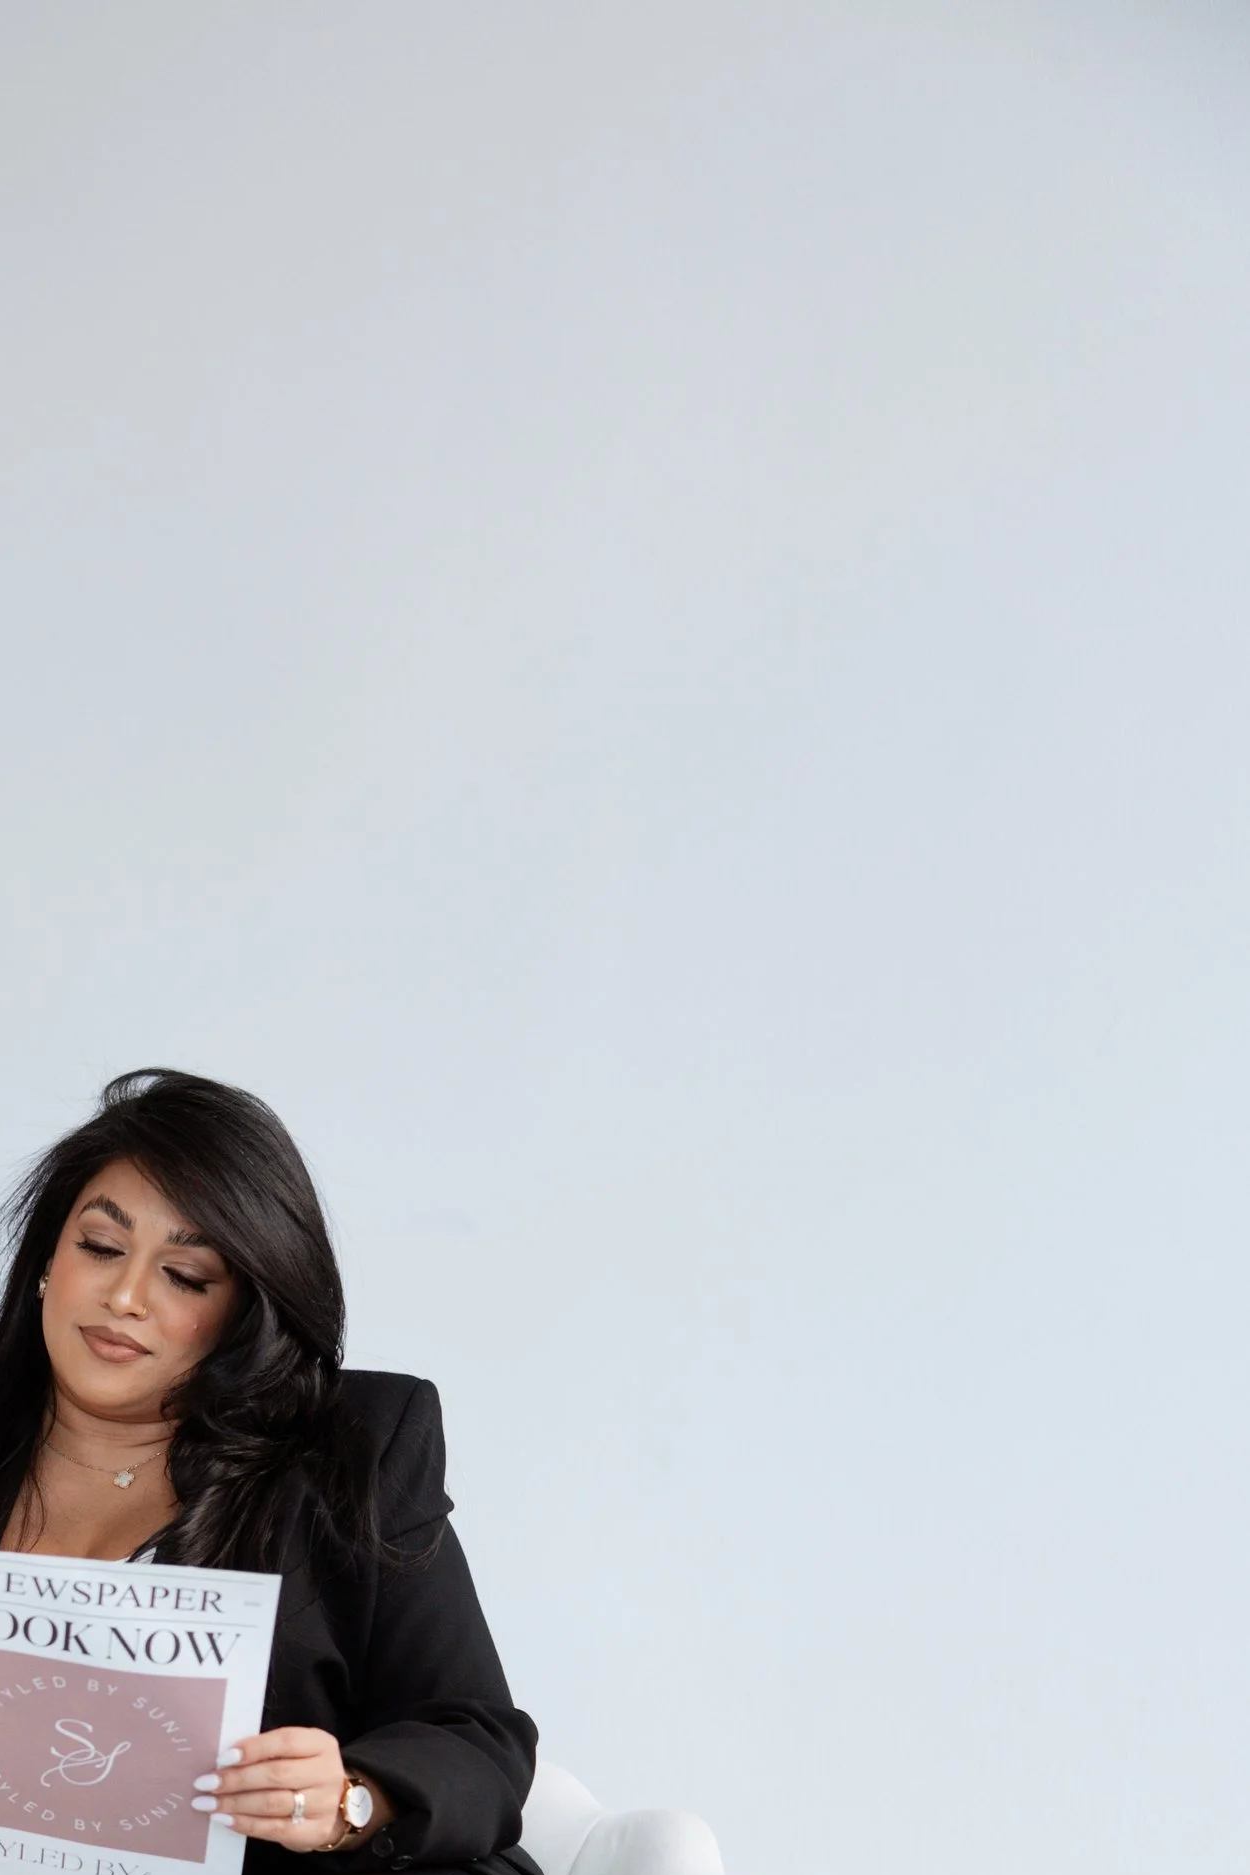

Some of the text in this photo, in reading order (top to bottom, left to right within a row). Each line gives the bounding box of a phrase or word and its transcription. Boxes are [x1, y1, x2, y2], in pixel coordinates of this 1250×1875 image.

[105, 1626, 242, 1667] NOW
[86, 1678, 118, 1696] BY
[131, 1696, 192, 1753] SUNJI
[73, 1818, 103, 1833] BY
[119, 1791, 185, 1832] SUNJI
